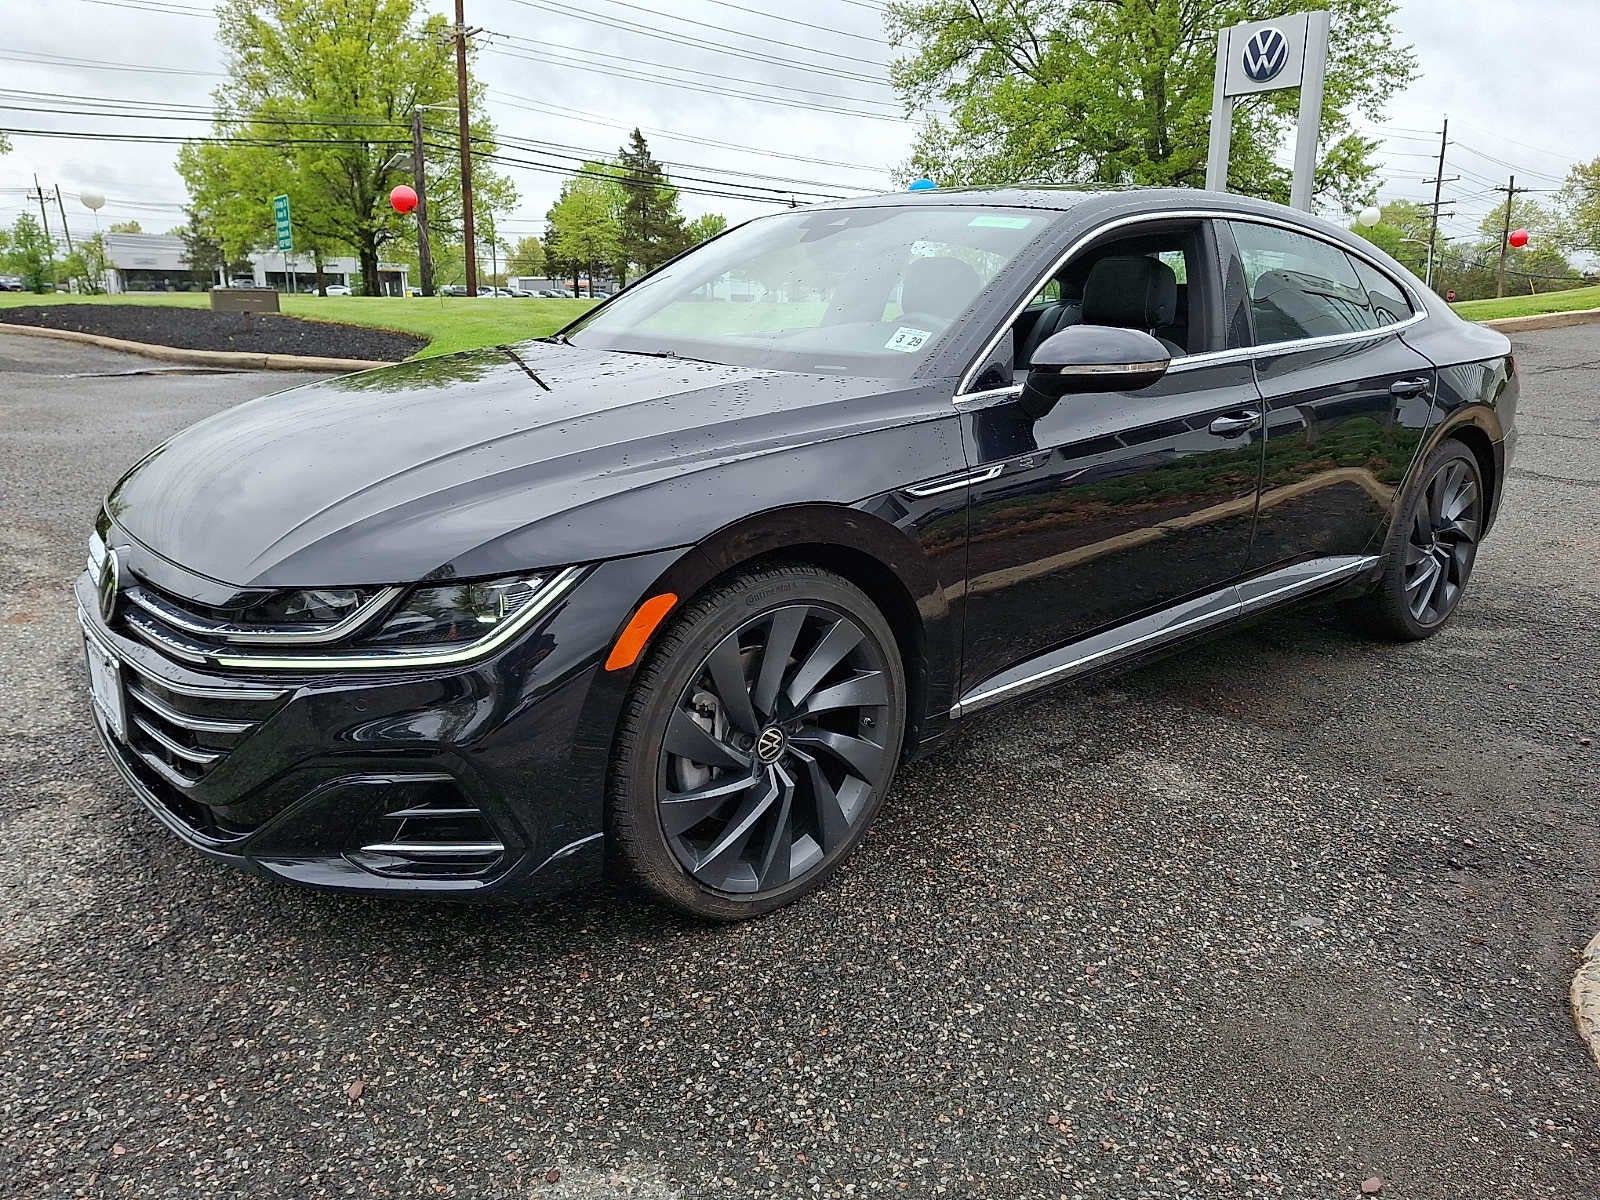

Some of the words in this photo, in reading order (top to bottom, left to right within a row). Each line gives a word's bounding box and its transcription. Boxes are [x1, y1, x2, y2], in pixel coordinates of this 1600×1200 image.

[1243, 28, 1288, 81] VW
[896, 335, 905, 343] 3
[759, 729, 783, 760] VW
